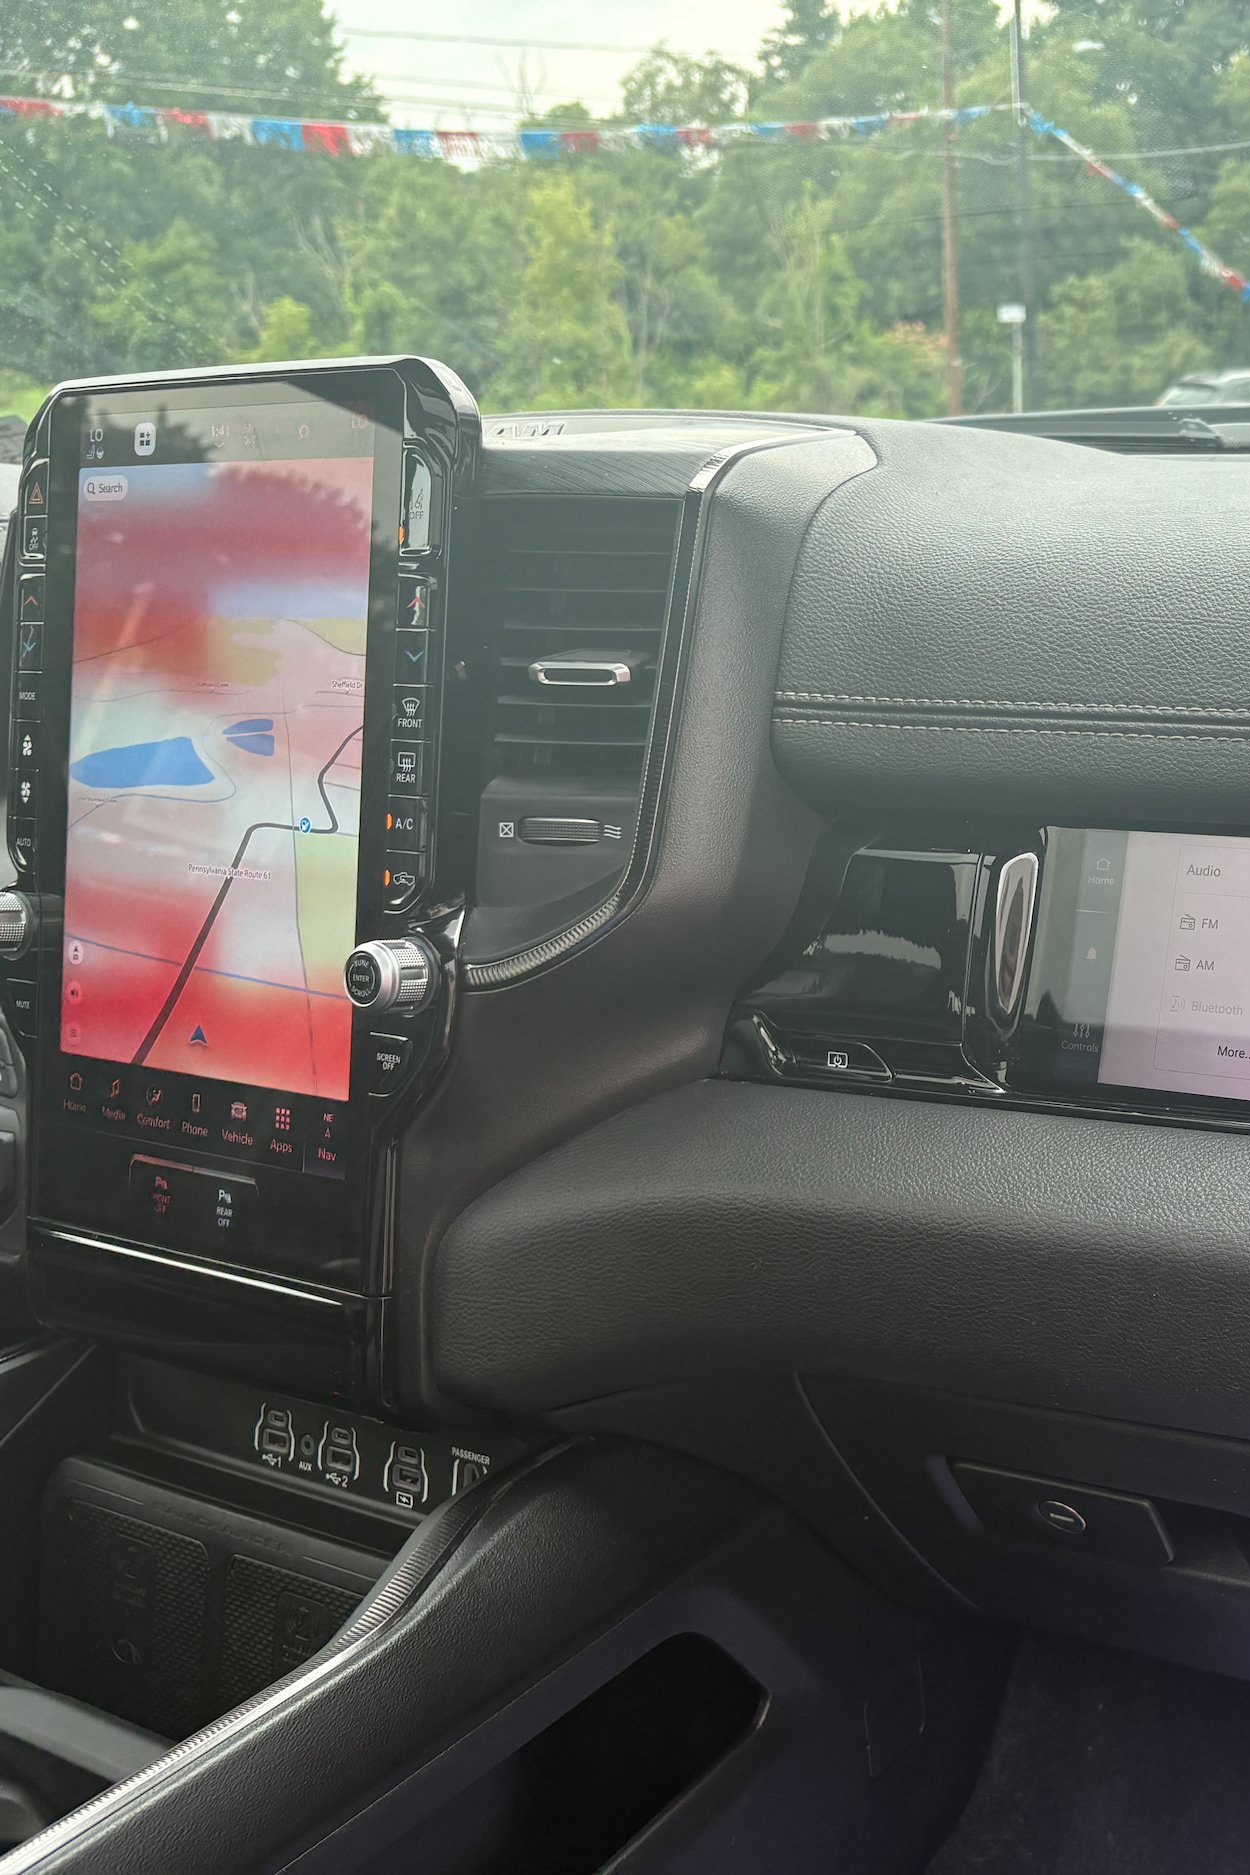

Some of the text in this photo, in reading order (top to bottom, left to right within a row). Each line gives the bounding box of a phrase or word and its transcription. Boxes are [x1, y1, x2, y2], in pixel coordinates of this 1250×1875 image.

[90, 429, 103, 442] LO
[99, 482, 123, 494] Search
[409, 511, 424, 520] OFF
[18, 691, 36, 700] MODE
[397, 718, 422, 728] FRONT
[396, 773, 416, 783] REAR
[395, 818, 414, 830] A/C
[16, 837, 32, 847] AUTO
[188, 863, 271, 880] Pennsylvania State Route 61
[1187, 864, 1221, 878] Audio
[1088, 875, 1115, 886] Home
[1201, 918, 1219, 930] FM
[354, 959, 370, 969] TUNE
[1196, 960, 1215, 971] AM
[353, 974, 370, 983] ENTER
[351, 984, 371, 998] SCROLL
[1191, 1000, 1243, 1016] Bluetooth
[1061, 1040, 1100, 1053] Controls
[376, 1052, 401, 1063] SCREEN
[382, 1062, 395, 1071] OFF
[64, 1099, 86, 1112] Home
[102, 1106, 125, 1120] Media
[323, 1113, 334, 1123] NE
[137, 1113, 170, 1130] Comfort
[182, 1121, 208, 1136] Phone
[222, 1129, 253, 1146] Vehicle
[270, 1139, 293, 1153] Apps
[319, 1148, 336, 1162] Nav
[216, 1206, 233, 1217] REAR
[218, 1218, 230, 1228] OFF
[452, 1446, 490, 1465] PASSENGER
[299, 1461, 312, 1472] AUX
[341, 1475, 349, 1488] 2
